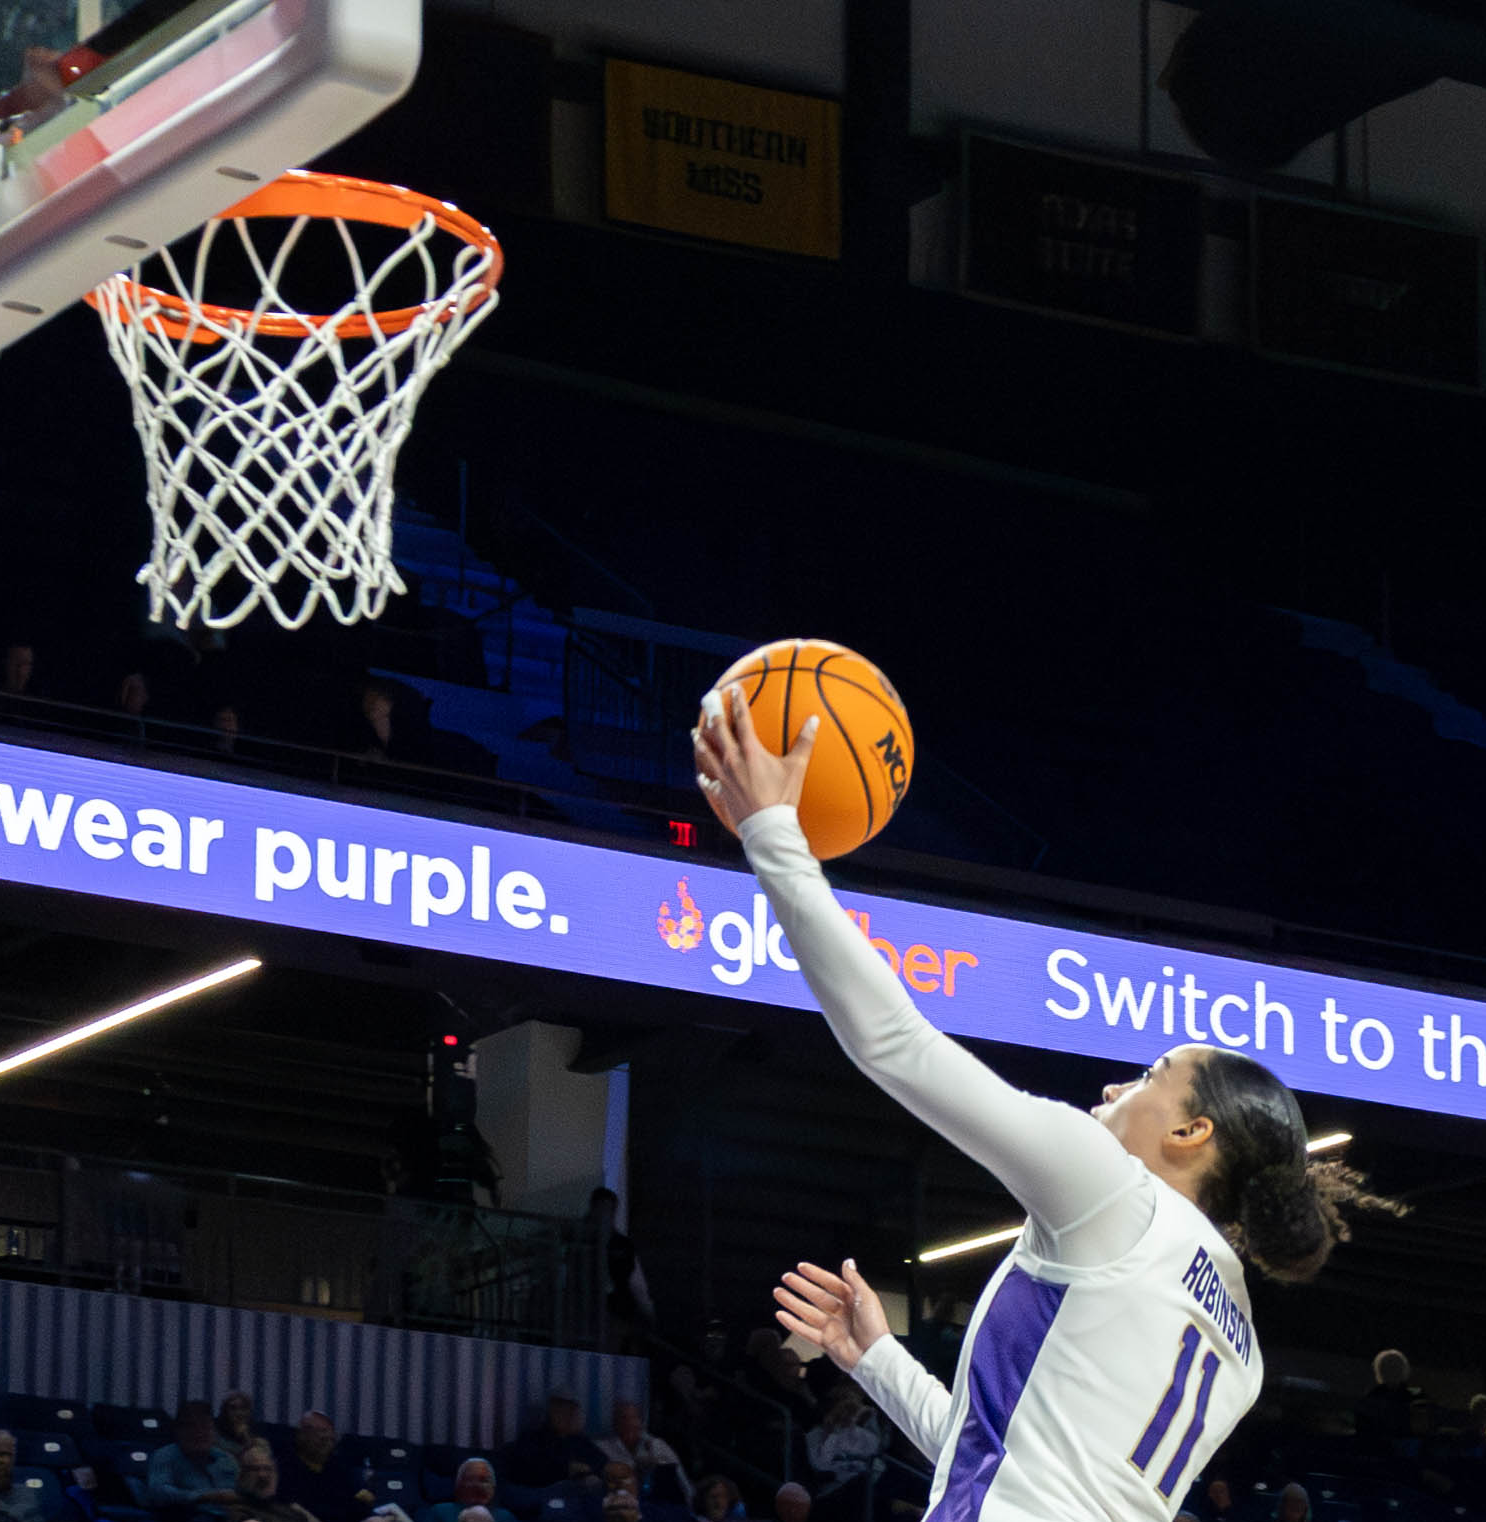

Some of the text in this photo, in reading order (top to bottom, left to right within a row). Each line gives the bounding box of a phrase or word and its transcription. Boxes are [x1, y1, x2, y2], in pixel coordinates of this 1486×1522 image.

[254, 824, 571, 936] purple.
[1045, 948, 1295, 1057] Switch
[1321, 997, 1394, 1073] to
[1181, 1245, 1252, 1368] ROBINSON
[1127, 1320, 1222, 1503] 11
